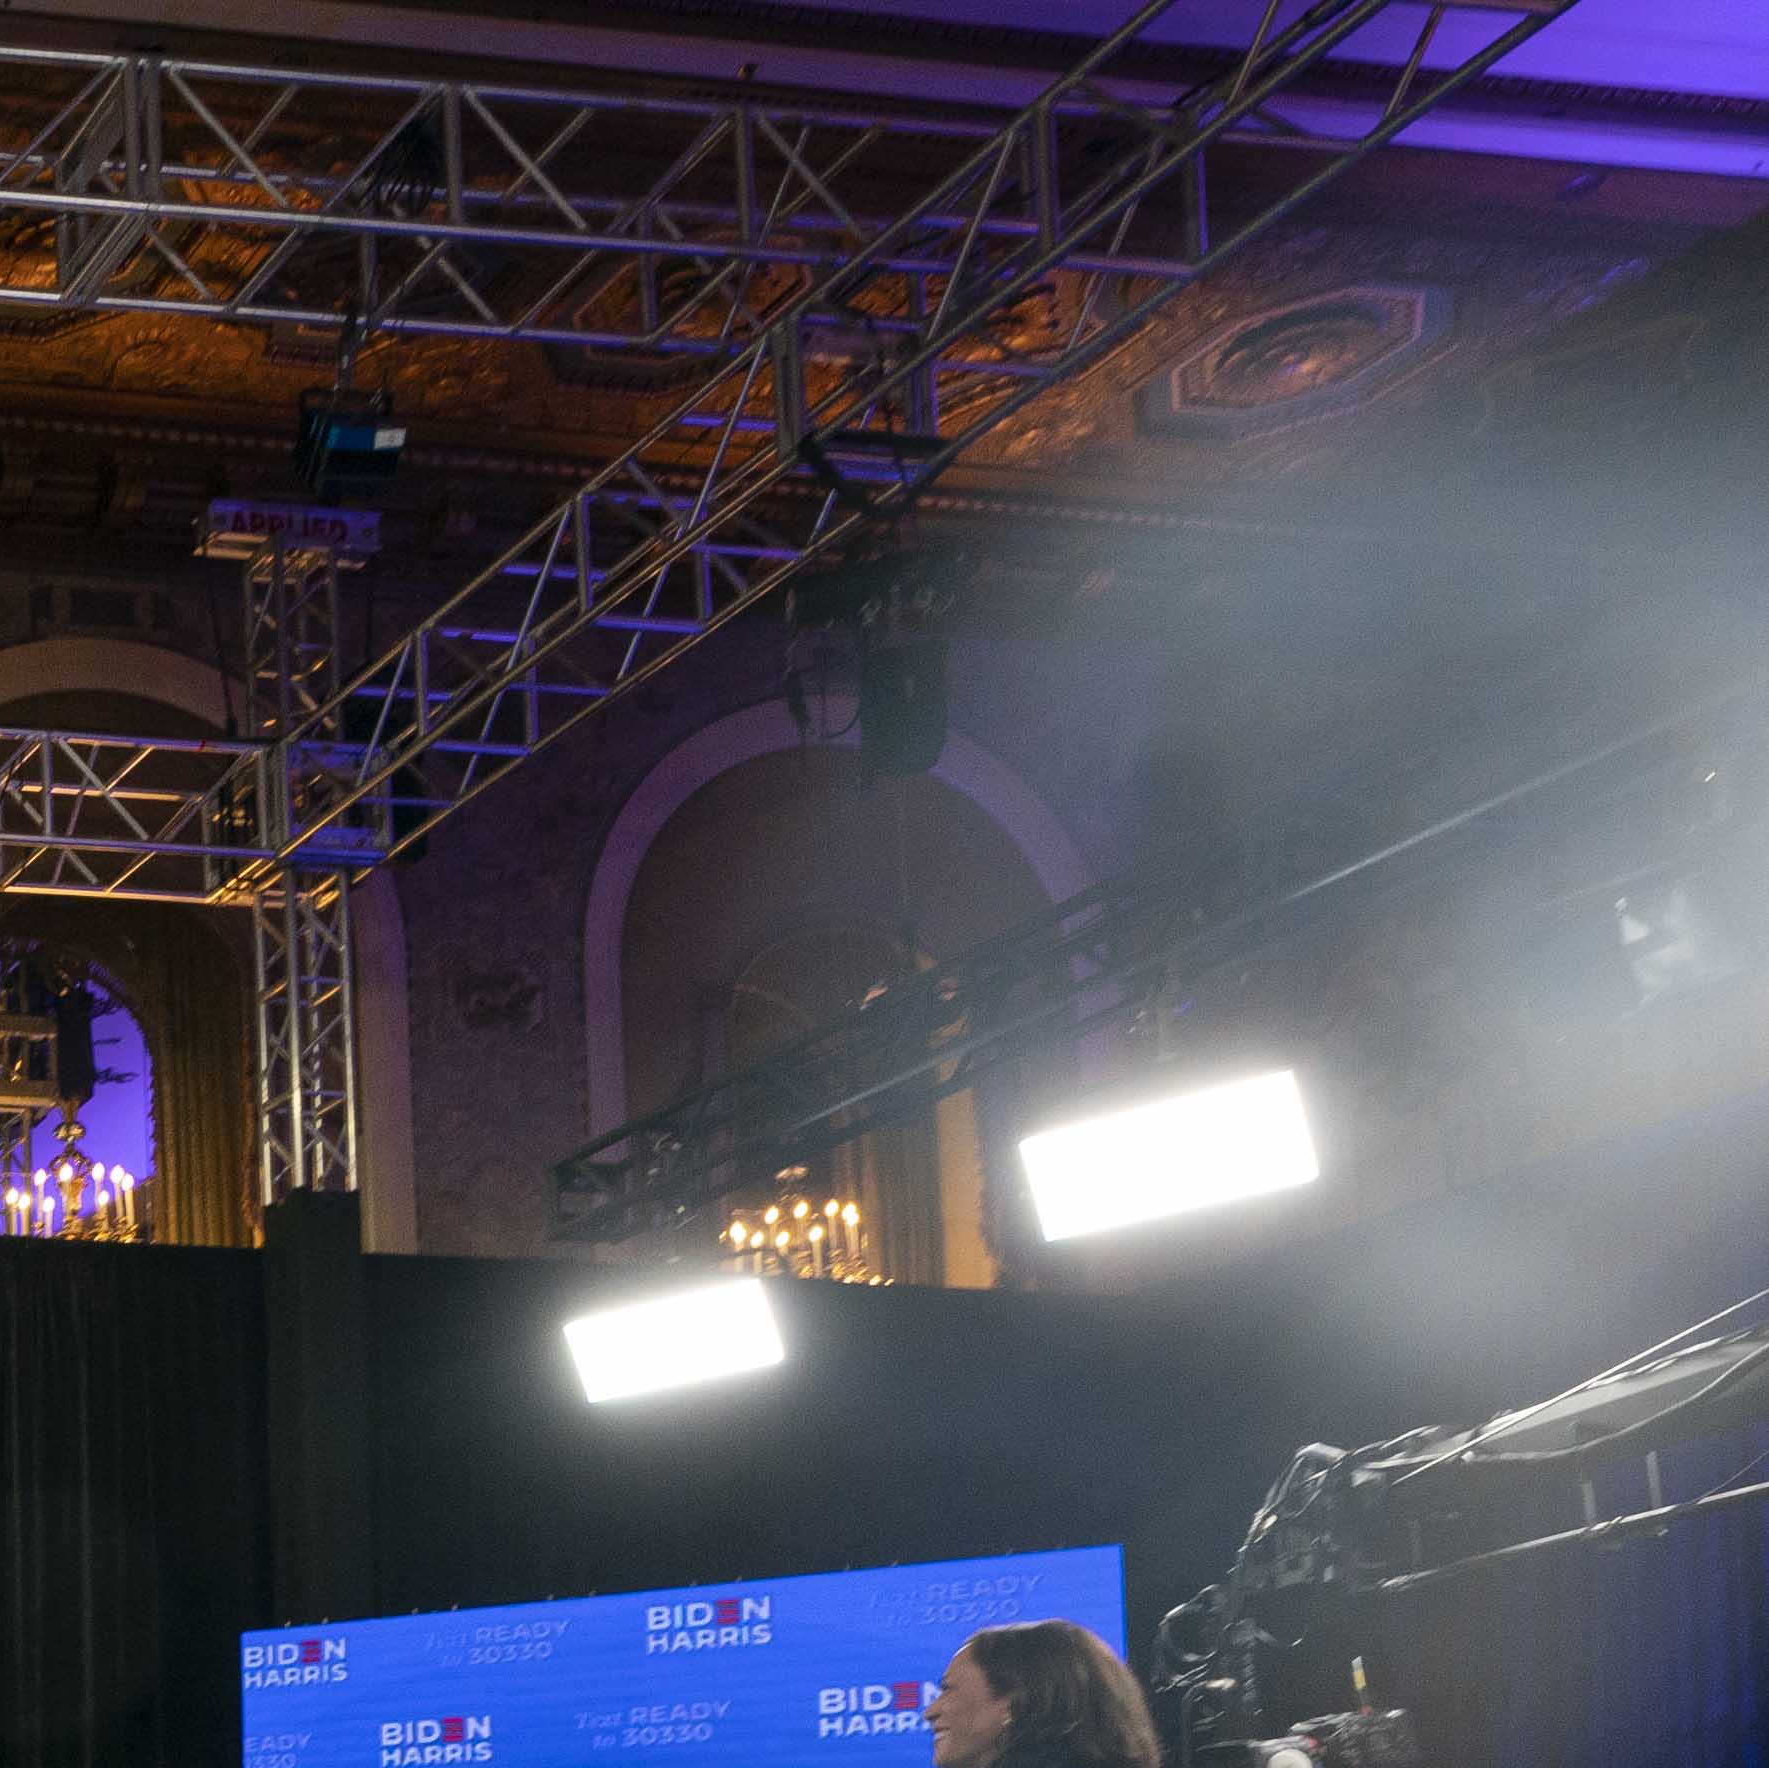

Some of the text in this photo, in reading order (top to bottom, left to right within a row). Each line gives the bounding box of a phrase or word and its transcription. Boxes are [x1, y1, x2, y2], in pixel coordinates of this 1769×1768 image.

[647, 1596, 771, 1631] BIDEN
[474, 1618, 572, 1644] READY
[646, 1623, 772, 1655] HARRIS
[243, 1637, 346, 1669] BIDEN
[468, 1640, 554, 1665] 30330
[244, 1663, 350, 1689] HARRIS
[628, 1699, 732, 1725] READY
[818, 1710, 930, 1739] HARR
[245, 1732, 312, 1752] EADY
[381, 1715, 492, 1747] BIDEN
[621, 1722, 713, 1748] 30330
[381, 1741, 493, 1768] HARRIS
